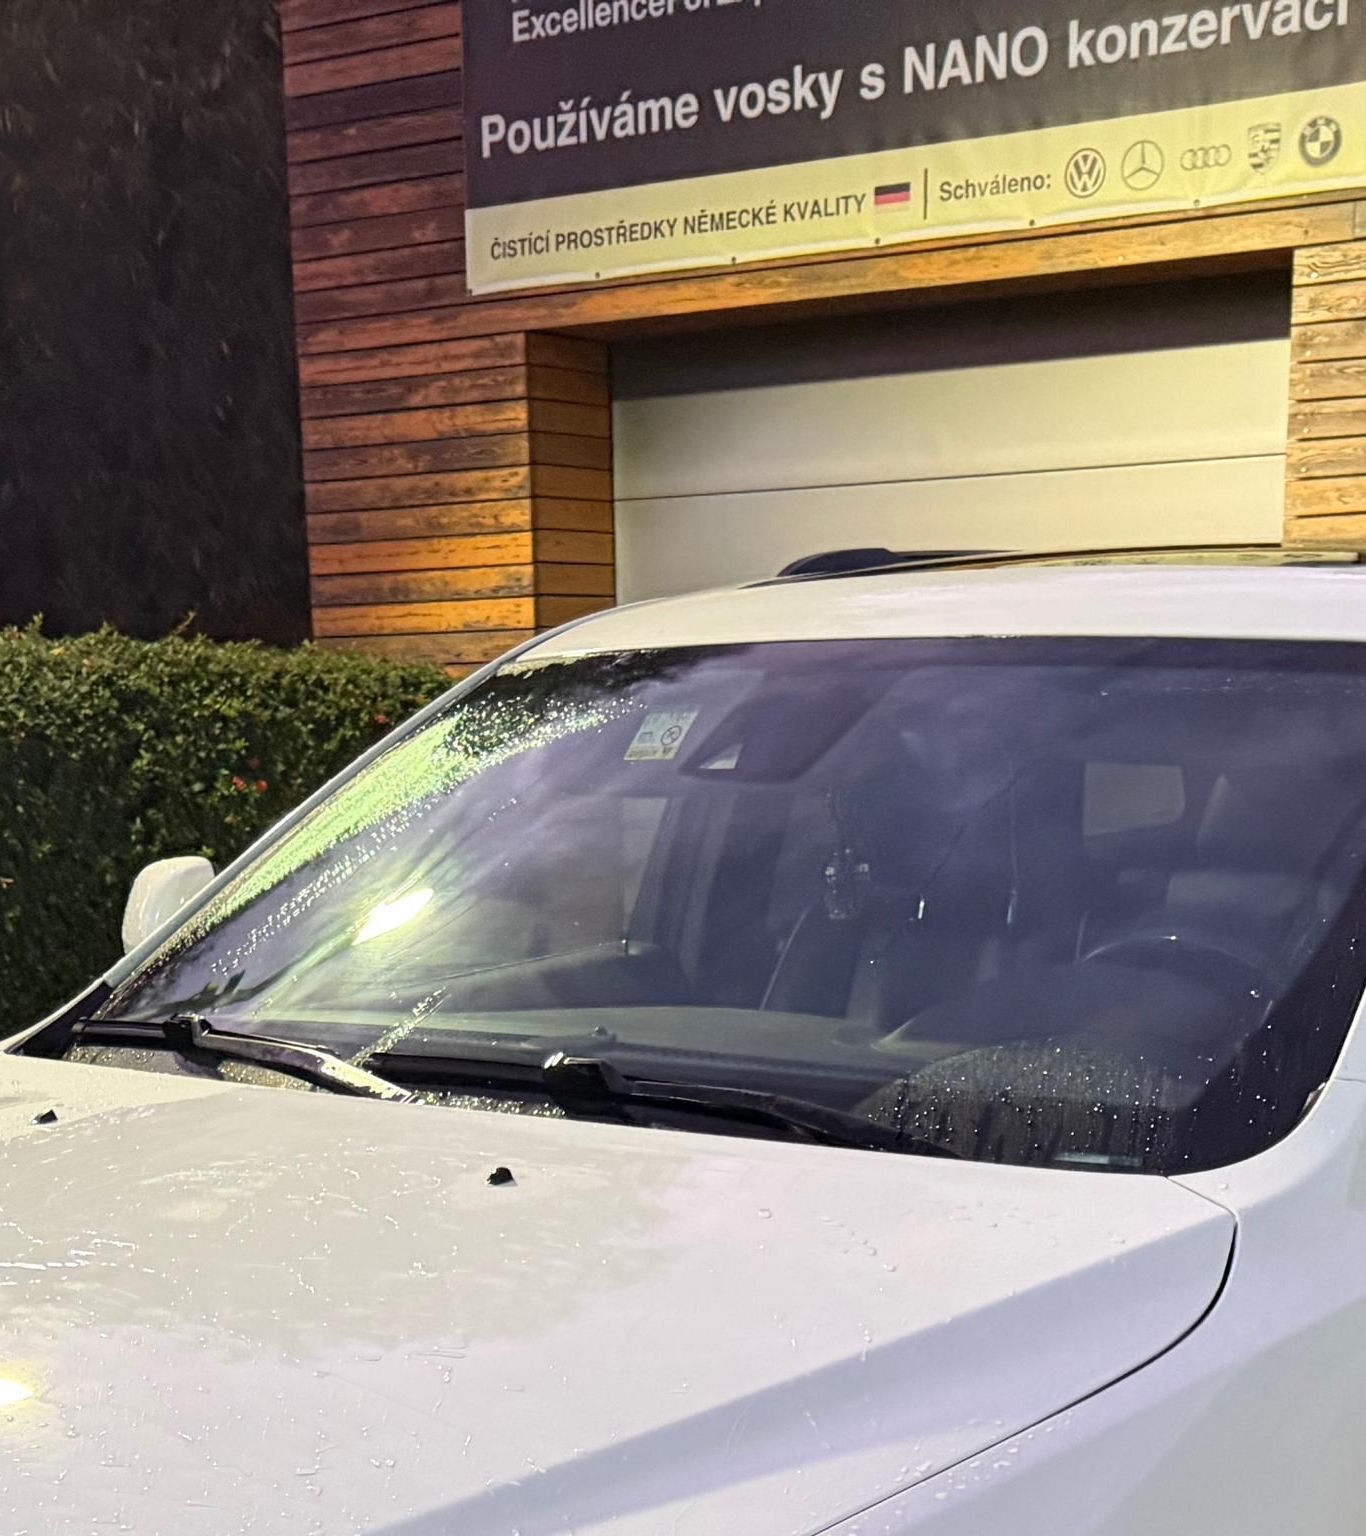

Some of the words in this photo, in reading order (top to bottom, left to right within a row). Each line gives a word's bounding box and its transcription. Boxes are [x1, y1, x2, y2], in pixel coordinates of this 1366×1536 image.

[480, 89, 700, 159] Používáme
[713, 64, 844, 123] vosky
[859, 60, 886, 101] s
[903, 25, 1049, 95] NANO
[939, 172, 1052, 202] Schváleno:
[490, 229, 551, 260] ČISTÍCÍ
[555, 218, 679, 252] PROSTŘEDKY
[683, 199, 778, 235] NĚMECKÉ
[783, 192, 867, 223] KVALITY
